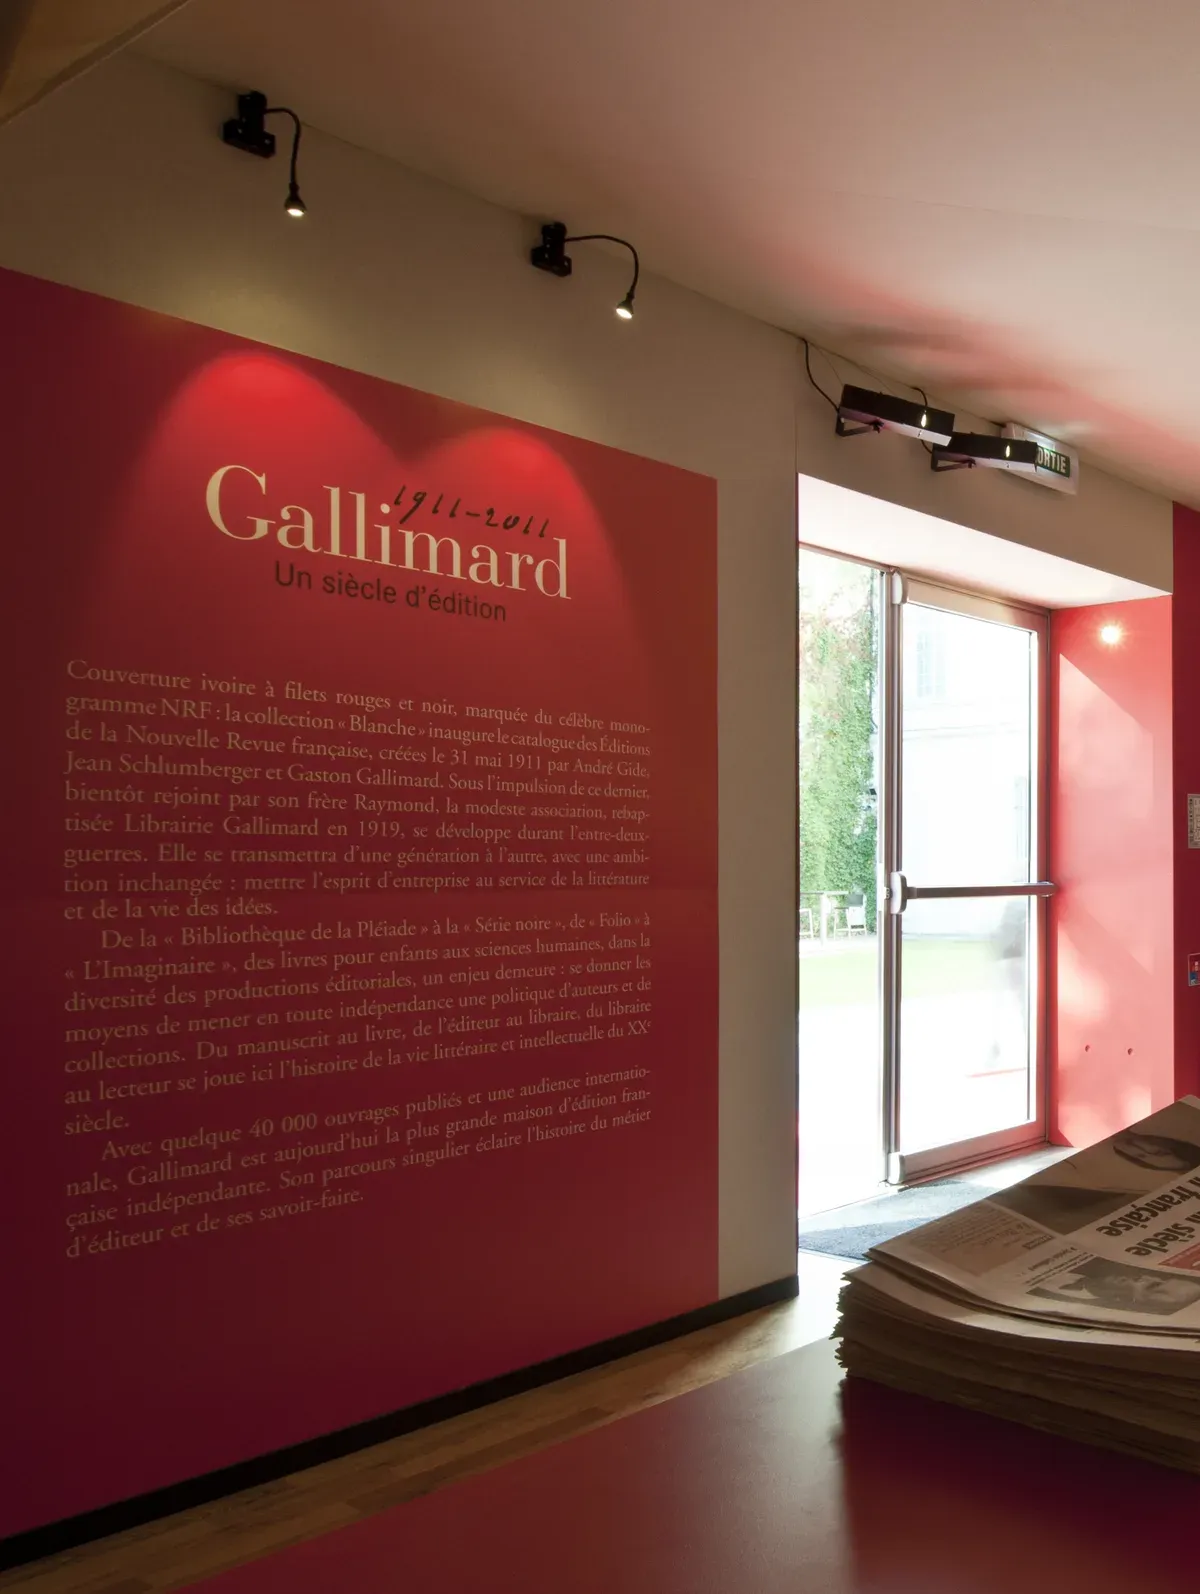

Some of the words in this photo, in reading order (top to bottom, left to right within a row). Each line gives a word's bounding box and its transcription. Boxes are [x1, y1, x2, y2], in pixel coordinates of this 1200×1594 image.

[1036, 446, 1066, 474] ORTIE
[205, 464, 572, 599] Gallimard
[394, 485, 550, 538] 1911-2011
[275, 561, 312, 590] Un
[324, 572, 396, 604] siècle
[406, 586, 507, 622] d'édition
[67, 659, 191, 689] Couverture
[201, 673, 256, 695] ivoire
[265, 680, 275, 697] à
[285, 680, 327, 702] filets
[336, 693, 391, 712] rouges
[398, 699, 414, 711] et
[421, 698, 457, 716] noir,
[465, 706, 528, 724] marquée
[534, 708, 552, 725] du
[559, 712, 604, 730] célèbre
[610, 721, 651, 733] mono-
[66, 720, 92, 740] de
[100, 722, 117, 742] la
[126, 724, 219, 749] Nouvelle
[227, 732, 285, 753] Revue
[292, 736, 373, 760] française,
[379, 745, 427, 762] créées
[432, 746, 445, 763] le
[450, 749, 467, 765] 31
[475, 752, 502, 767] mai
[509, 754, 540, 769] 1911
[548, 760, 570, 776] par
[572, 758, 613, 774] André
[617, 761, 650, 778] Gide,
[63, 750, 112, 774] Jean
[119, 754, 262, 784] Schlumberger
[265, 768, 283, 780] et
[287, 764, 351, 783] Gaston
[356, 768, 444, 788] Gallimard.
[448, 773, 484, 790] Sous
[488, 775, 566, 797] l'impulsion
[569, 780, 585, 795] de
[587, 786, 601, 796] ce
[604, 782, 650, 800] dernier,
[65, 780, 144, 803] bientôt
[154, 786, 220, 809] rejoint
[229, 794, 260, 812] par
[268, 796, 299, 808] son
[308, 791, 347, 810] frère
[354, 794, 439, 816] Raymond,
[446, 797, 458, 813] la
[465, 799, 525, 816] modeste
[530, 803, 607, 819] association,
[612, 805, 650, 824] rebap-
[65, 812, 113, 832] tisée
[125, 813, 213, 834] Librairie
[223, 816, 318, 836] Gallimard
[327, 825, 348, 836] en
[360, 821, 405, 839] 1919,
[413, 827, 428, 838] se
[436, 822, 511, 844] développe
[517, 824, 563, 840] durant
[571, 825, 649, 842] l'entre-deux-
[63, 849, 148, 868] guerres.
[158, 843, 197, 862] Elle
[204, 850, 223, 862] se
[231, 850, 337, 862] transmettra
[344, 845, 392, 862] d'une
[397, 847, 479, 868] génération
[486, 848, 493, 863] à
[499, 847, 547, 863] l'autre,
[552, 853, 580, 863] avec
[586, 853, 610, 863] une
[613, 849, 650, 863] ambi-
[64, 906, 84, 920] et
[92, 899, 118, 919] de
[125, 898, 143, 918] la
[149, 899, 179, 917] vie
[186, 897, 219, 916] des
[226, 896, 278, 915] idées.
[64, 1109, 129, 1135] siècle.
[66, 1228, 164, 1258] d'éditeur
[170, 1223, 190, 1238] et
[196, 1213, 220, 1232] de
[227, 1211, 254, 1227] ses
[259, 1188, 364, 1221] savoir-faire.
[1125, 1223, 1196, 1256] siècle
